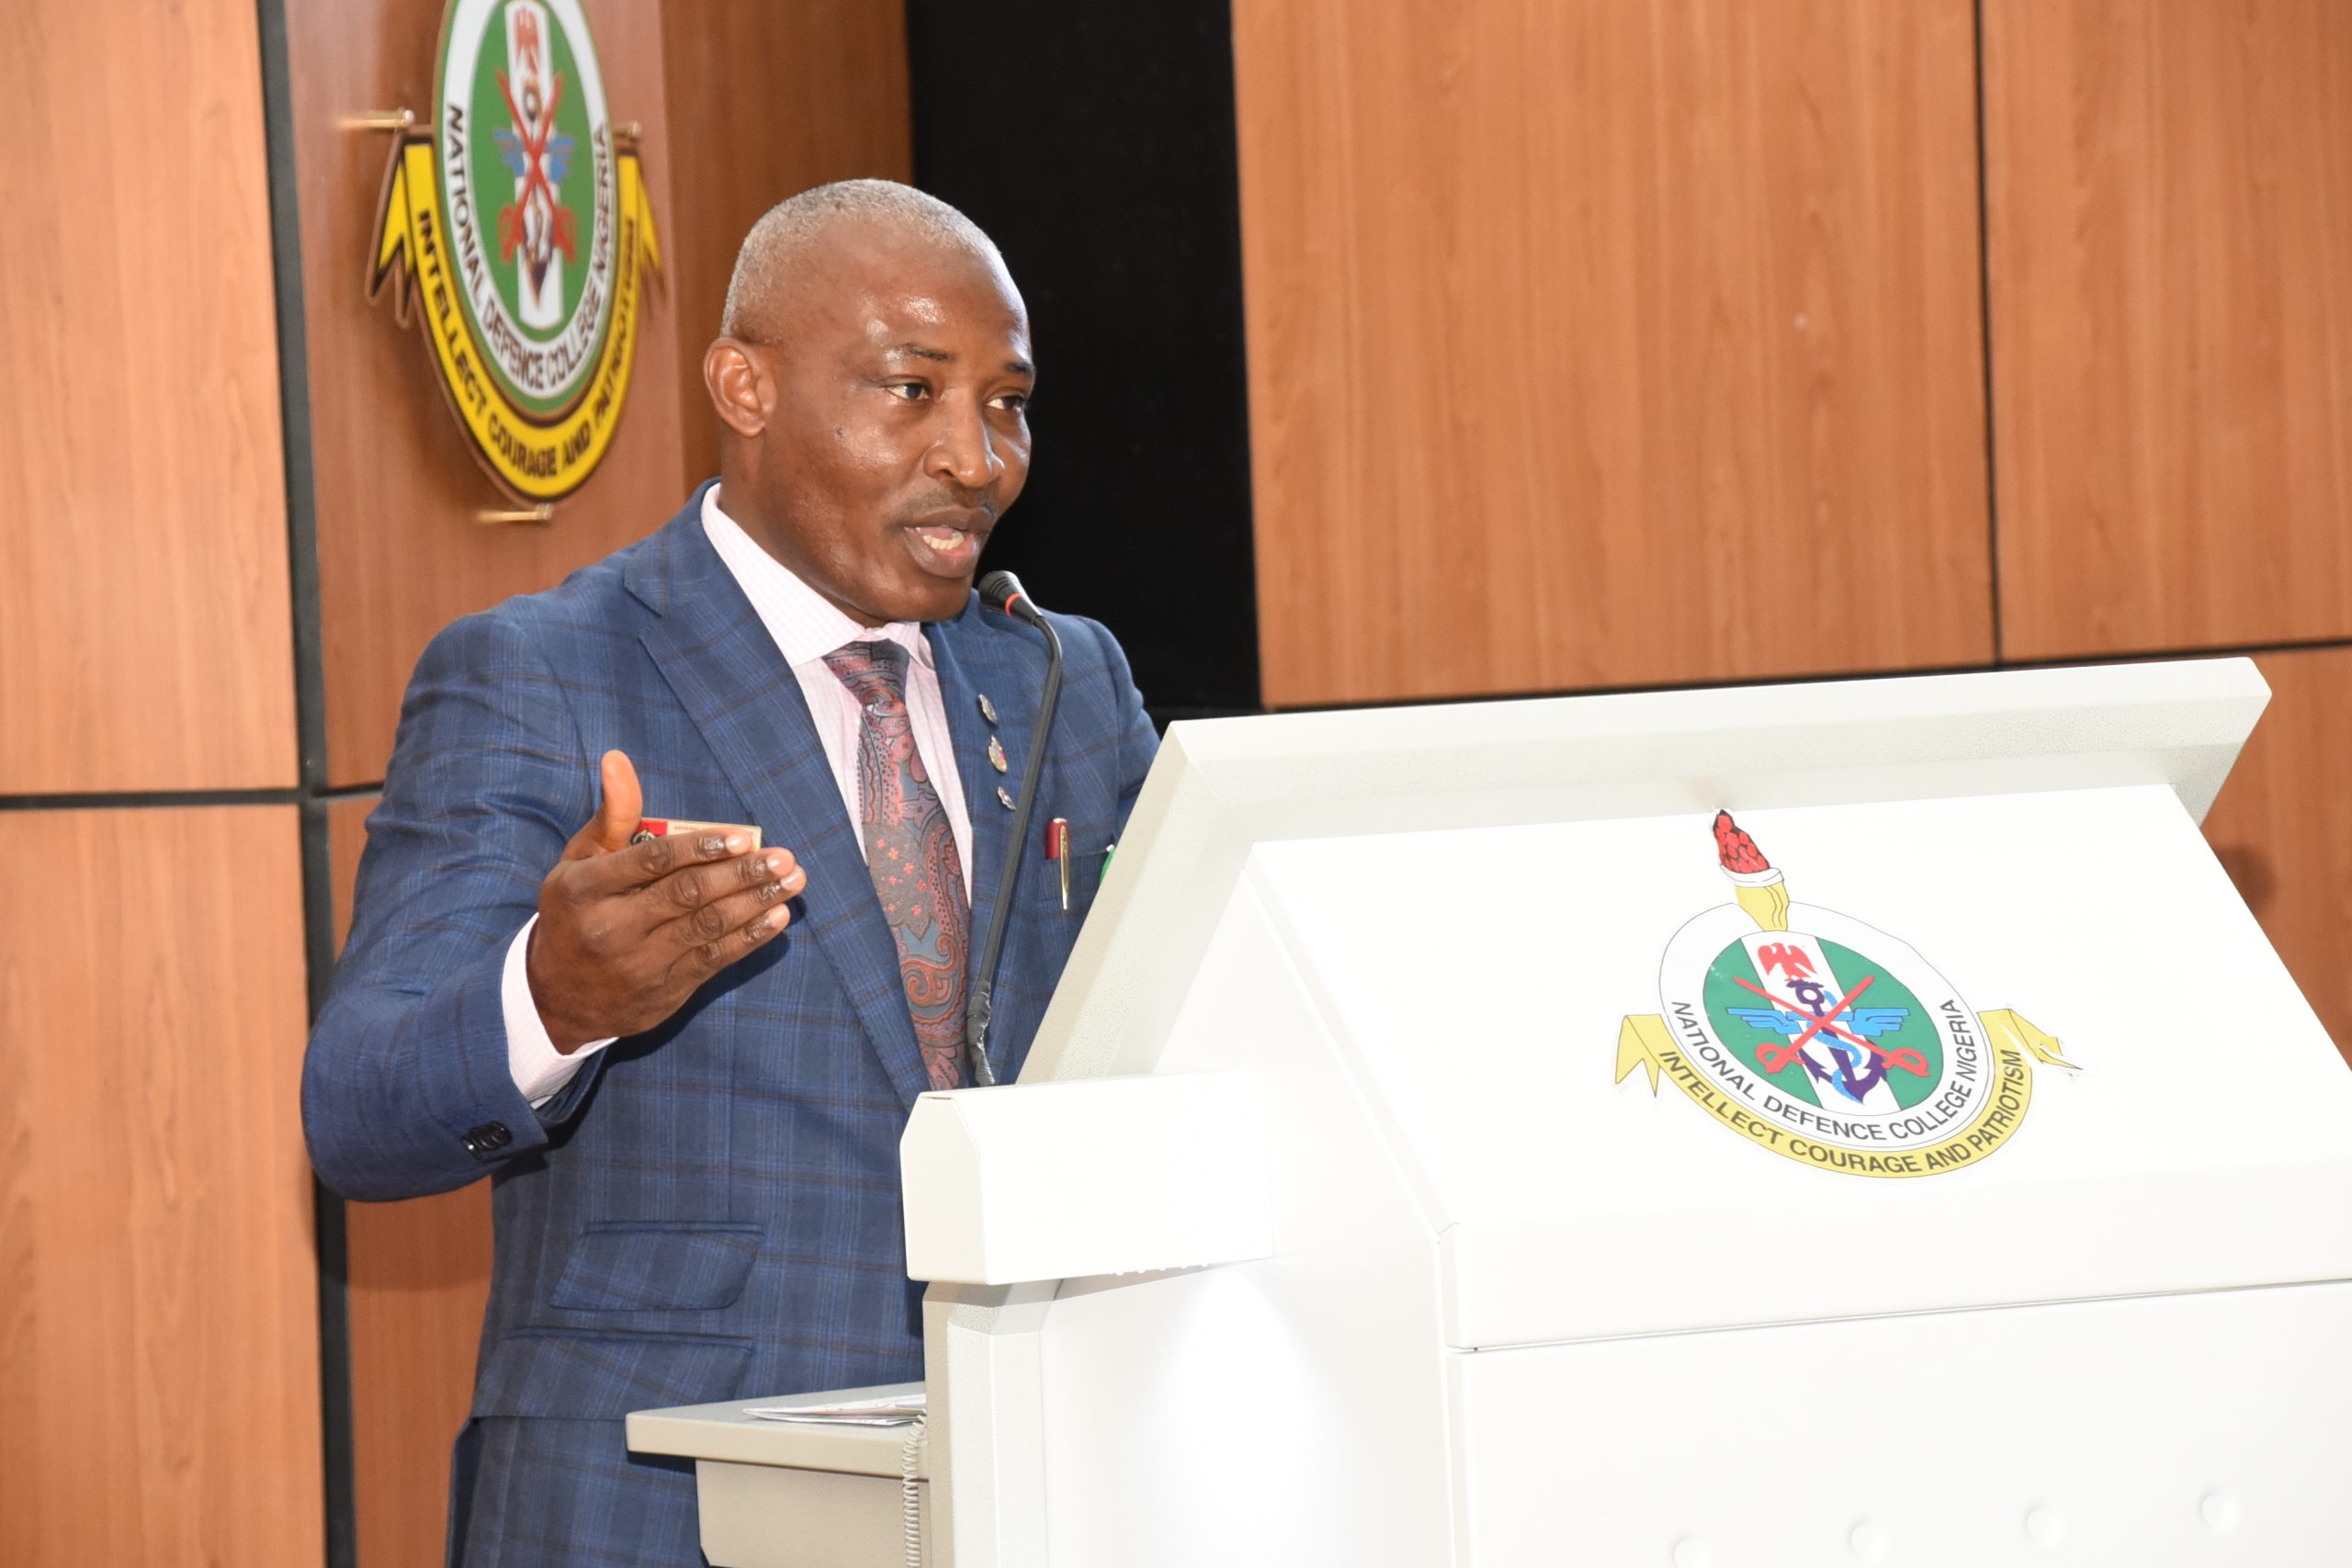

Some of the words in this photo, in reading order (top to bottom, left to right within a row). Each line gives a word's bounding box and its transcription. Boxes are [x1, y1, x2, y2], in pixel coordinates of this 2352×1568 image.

[418, 209, 487, 418] INTELLECT
[488, 411, 557, 478] COURAGE
[562, 419, 592, 470] AND
[447, 103, 483, 306] NATIONAL
[482, 294, 544, 390] DEFENCE
[546, 279, 601, 388] COLLEGE
[1658, 1051, 1784, 1145] INTELLECT
[1789, 1139, 1923, 1173] COURAGE
[1925, 1143, 1972, 1170] AND
[1966, 1049, 2024, 1152] PATRIOTISM
[1671, 1001, 1756, 1101] NATIONAL
[1763, 1094, 1887, 1141] DEFENCE
[1888, 1080, 1973, 1139] COLLEGE
[1939, 999, 1977, 1082] NIGERIA
